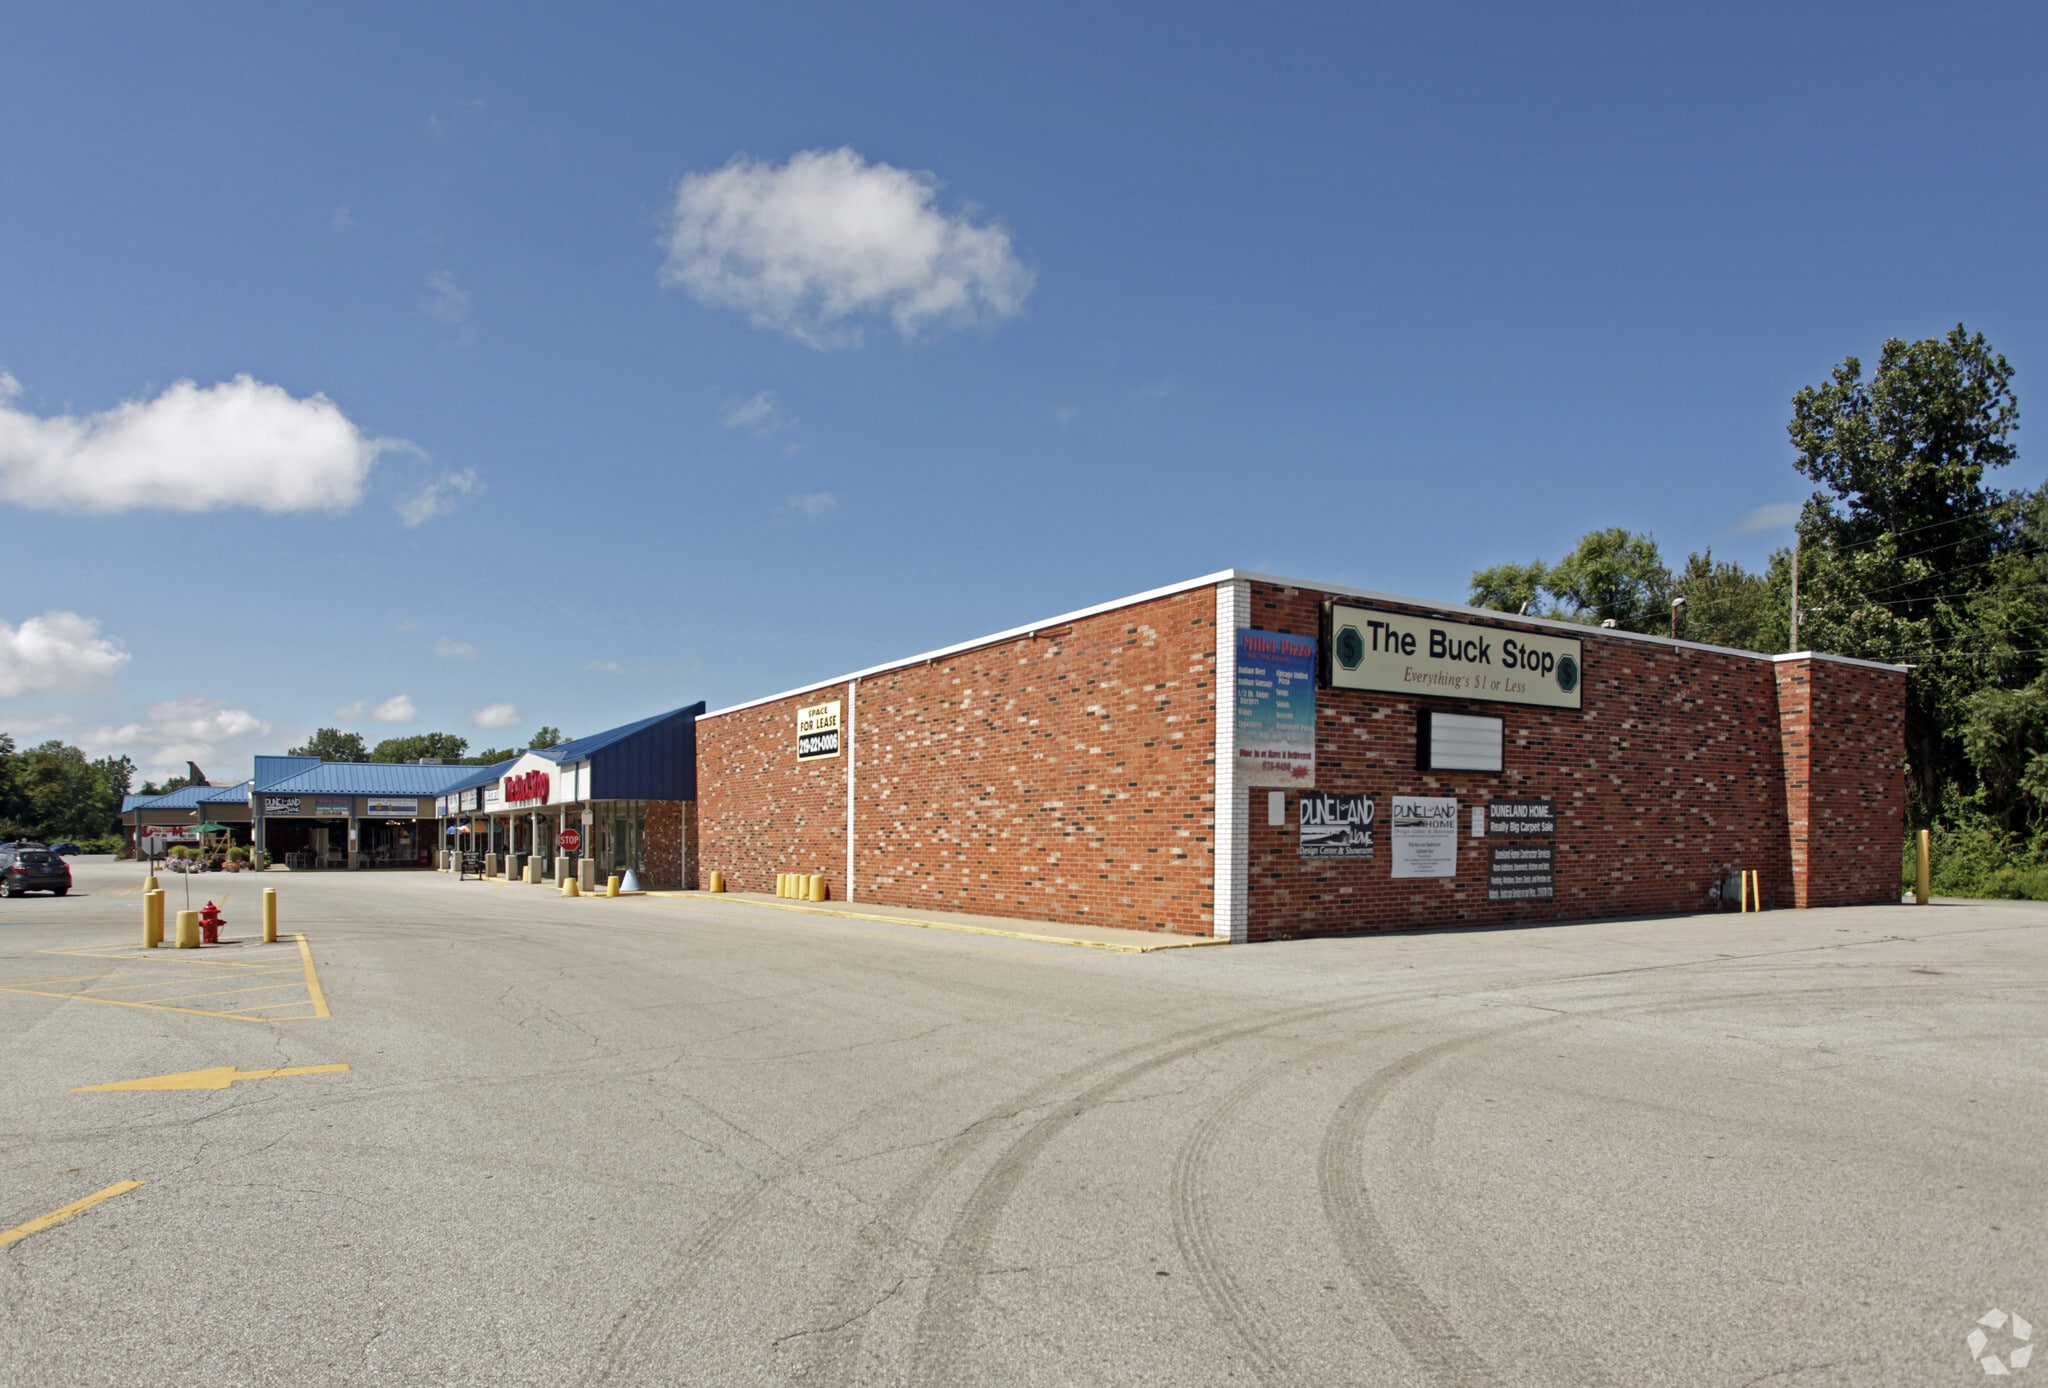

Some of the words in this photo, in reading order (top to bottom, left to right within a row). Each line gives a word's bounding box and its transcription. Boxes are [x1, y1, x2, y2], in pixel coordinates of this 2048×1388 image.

[1243, 635, 1277, 654] Miller
[1281, 639, 1312, 657] Pizza
[1366, 620, 1416, 656] The
[1429, 629, 1491, 665] Buck
[1502, 639, 1554, 677] Stop
[1404, 666, 1470, 689] Everything's
[1474, 673, 1487, 690] $1
[1490, 680, 1500, 691] or
[1505, 677, 1526, 694] Less
[808, 706, 828, 718] SPACE
[800, 720, 814, 732] FOR
[816, 715, 837, 729] LEASE
[1299, 793, 1375, 825] DUNELAND
[1394, 802, 1456, 818] DUNELAND
[1490, 804, 1528, 818] DUNELAND
[1425, 820, 1455, 828] HOME
[1490, 822, 1509, 833] Really
[1509, 822, 1520, 833] Big
[1520, 822, 1541, 833] Carpet
[1541, 821, 1553, 832] Sale
[560, 836, 579, 845] STOP
[1299, 847, 1319, 856] Design
[1320, 847, 1338, 855] Center
[1338, 847, 1344, 855] &
[1345, 847, 1374, 855] Showroom
